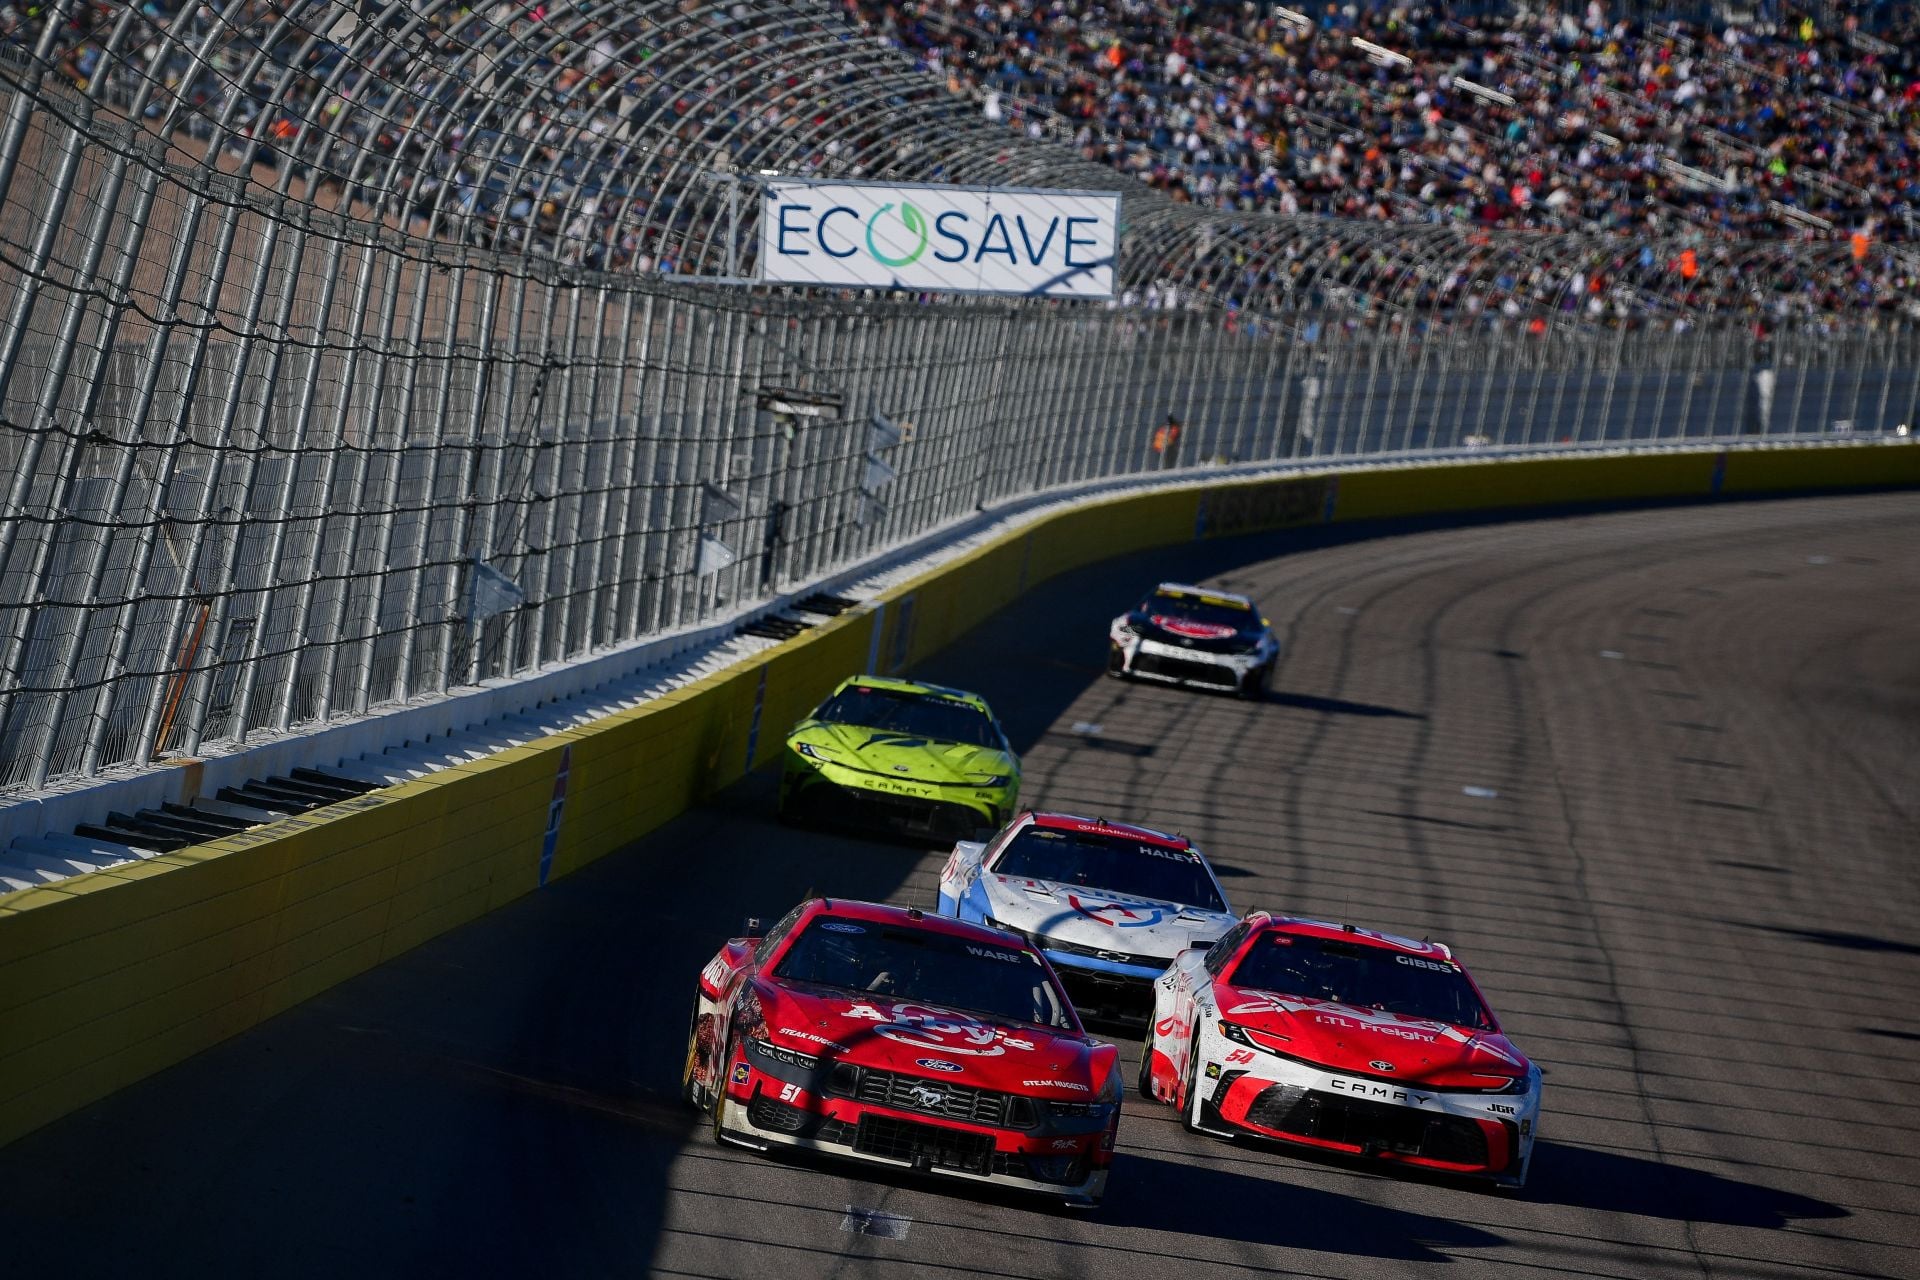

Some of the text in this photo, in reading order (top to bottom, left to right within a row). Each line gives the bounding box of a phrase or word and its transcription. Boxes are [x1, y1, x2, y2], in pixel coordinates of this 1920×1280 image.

[777, 201, 1099, 268] ECOSAVE
[863, 779, 932, 796] CAMRY
[1139, 846, 1193, 864] HALEY
[965, 945, 1021, 964] WARE
[1395, 955, 1452, 974] GIBBS
[1315, 1014, 1437, 1044] LTL Freight
[779, 1027, 851, 1054] STEAK NUGGETS
[1225, 1049, 1257, 1065] 54
[779, 1082, 801, 1103] 51
[1331, 1079, 1432, 1105] CAMRY
[1486, 1103, 1516, 1116] JGR
